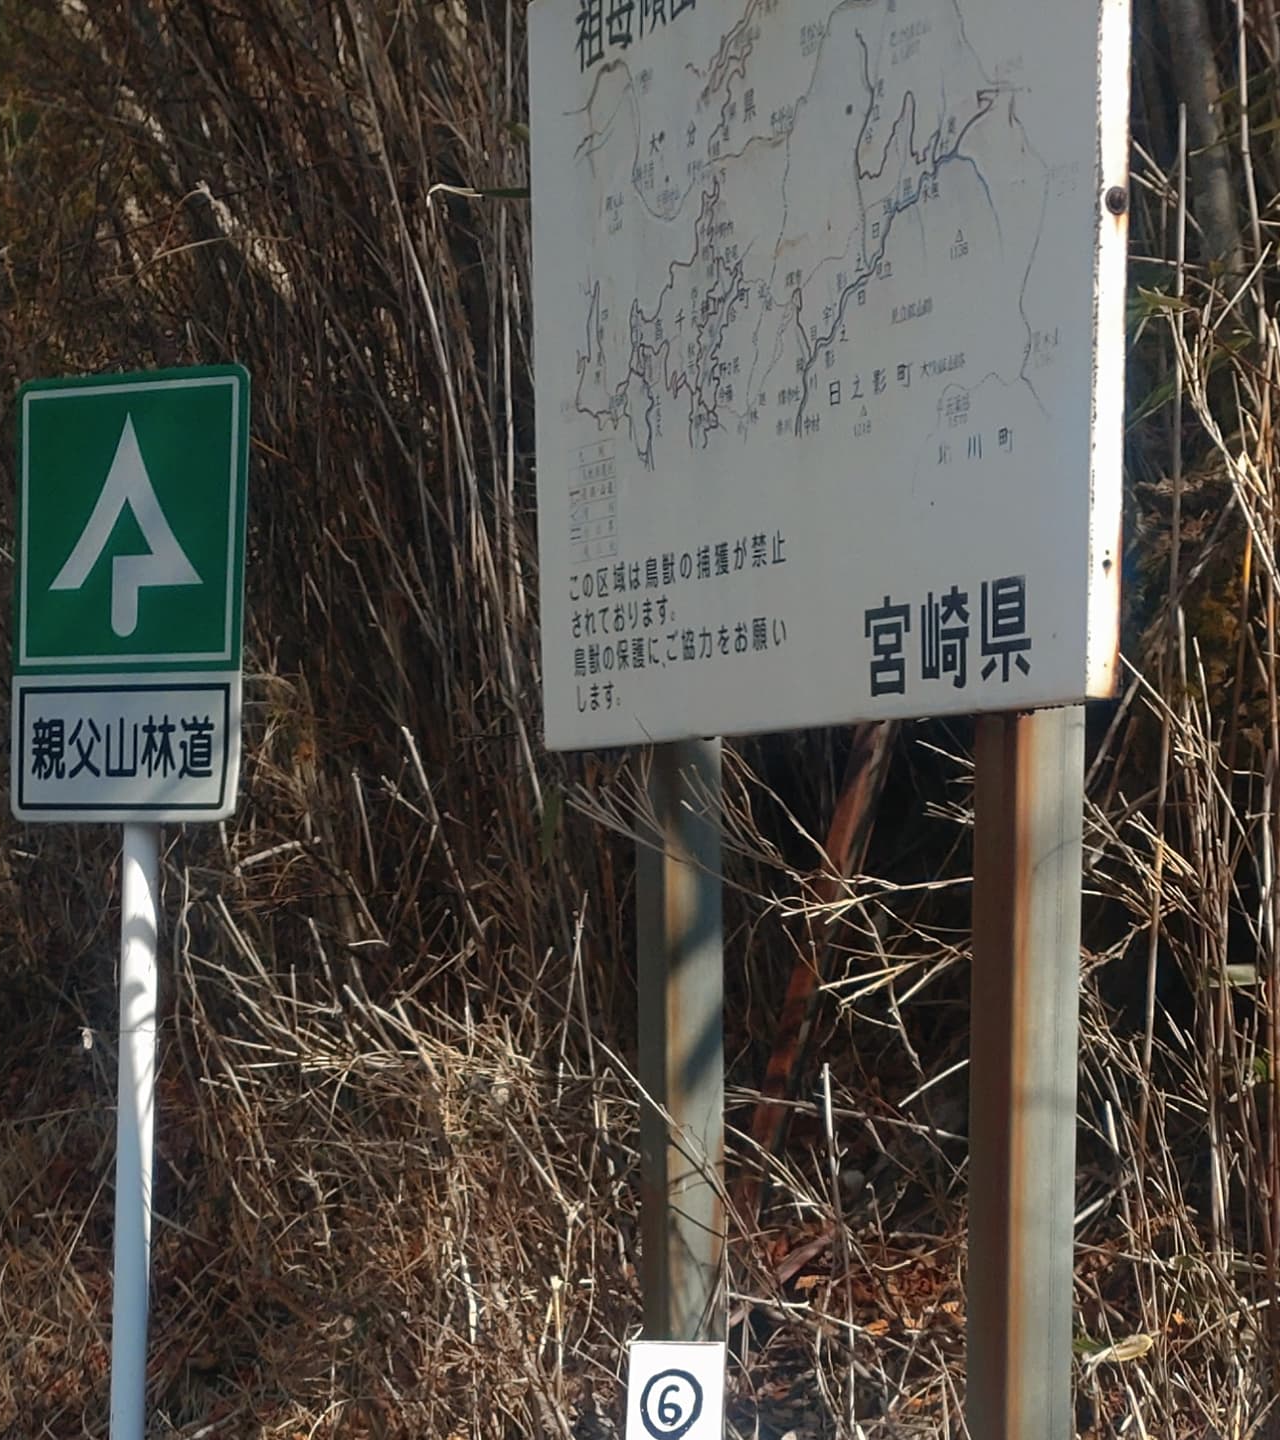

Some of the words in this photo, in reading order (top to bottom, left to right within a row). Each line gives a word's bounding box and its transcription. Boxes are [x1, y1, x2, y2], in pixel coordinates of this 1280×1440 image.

[575, 0, 696, 72] 祖母
[569, 529, 787, 601] この区域は鳥獣の捕獲が禁止
[863, 575, 1033, 698] 宮崎県
[30, 713, 215, 781] 親父山林道
